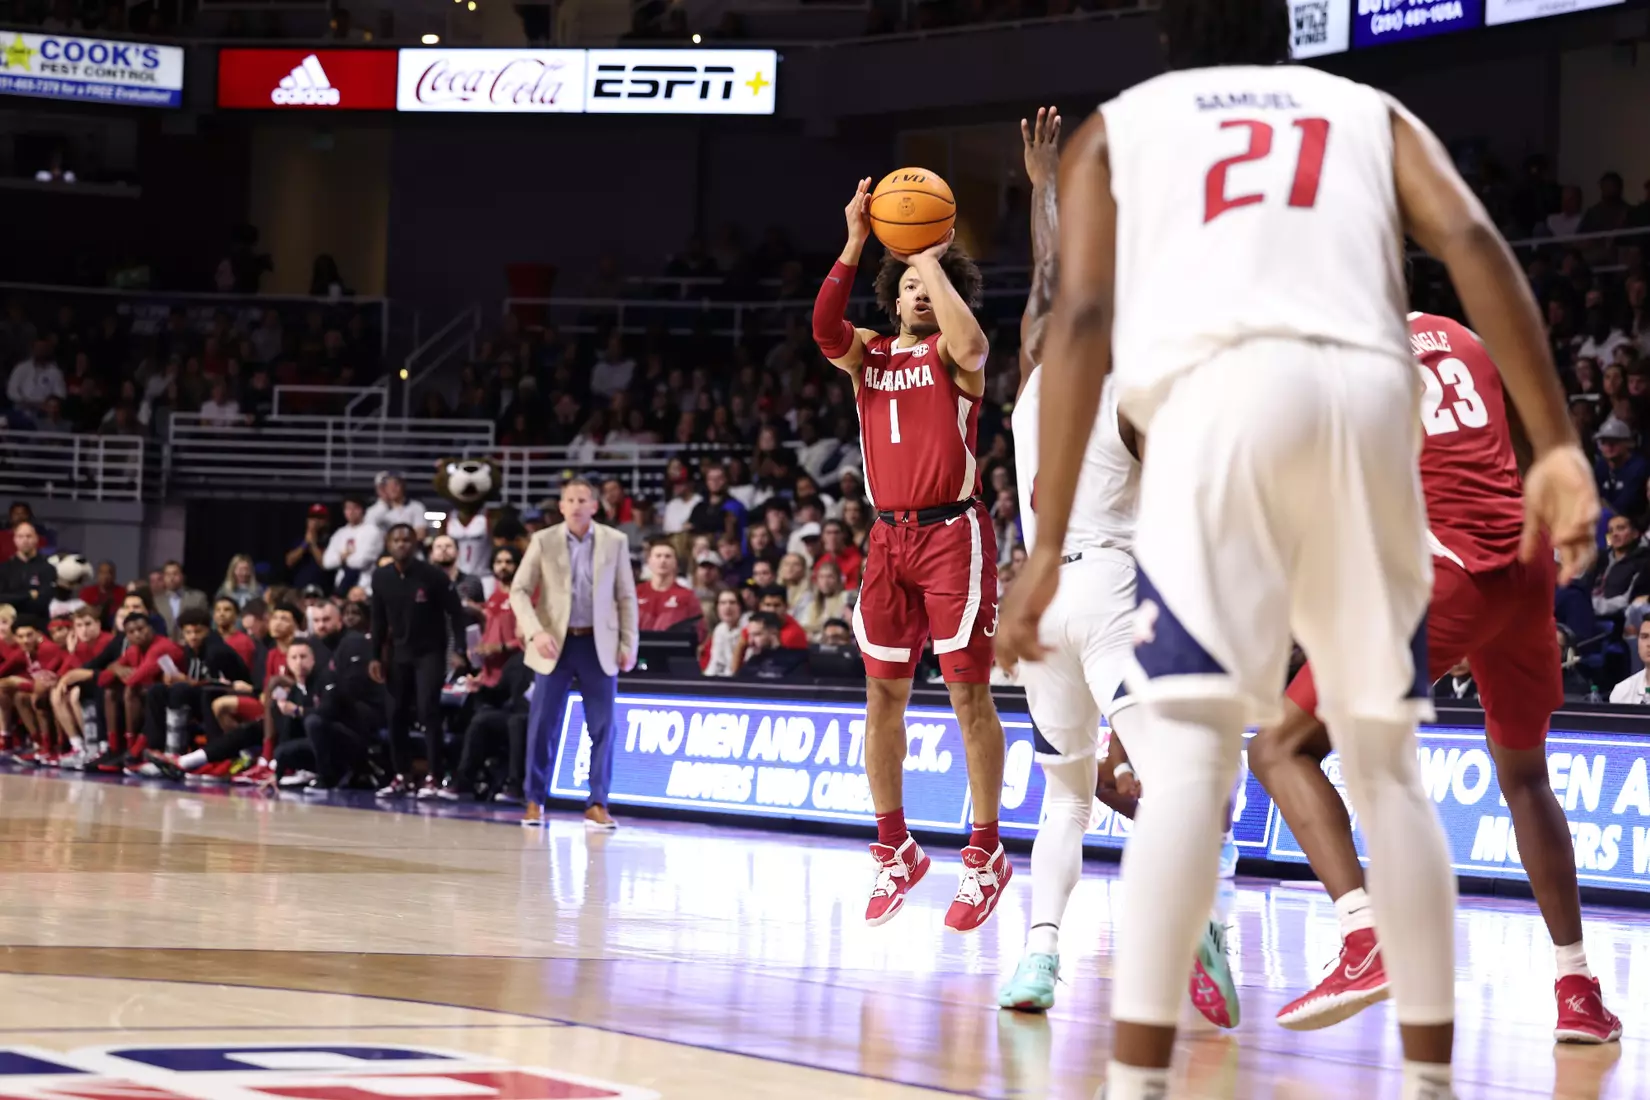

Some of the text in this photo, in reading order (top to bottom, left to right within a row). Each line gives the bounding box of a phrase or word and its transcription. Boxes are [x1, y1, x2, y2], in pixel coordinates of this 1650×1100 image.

[40, 38, 161, 69] COOK'S
[40, 63, 157, 83] PEST CONTROL
[1195, 92, 1302, 111] SAMUEL
[1202, 117, 1331, 225] 21
[864, 364, 934, 391] ALABAMA
[1417, 357, 1489, 437] 23
[889, 398, 901, 444] 1
[625, 709, 685, 755] TWO
[685, 713, 749, 758] MEN
[748, 716, 815, 763] AND
[814, 719, 841, 765] A
[847, 719, 952, 773] TCK.
[1417, 747, 1492, 805] WO
